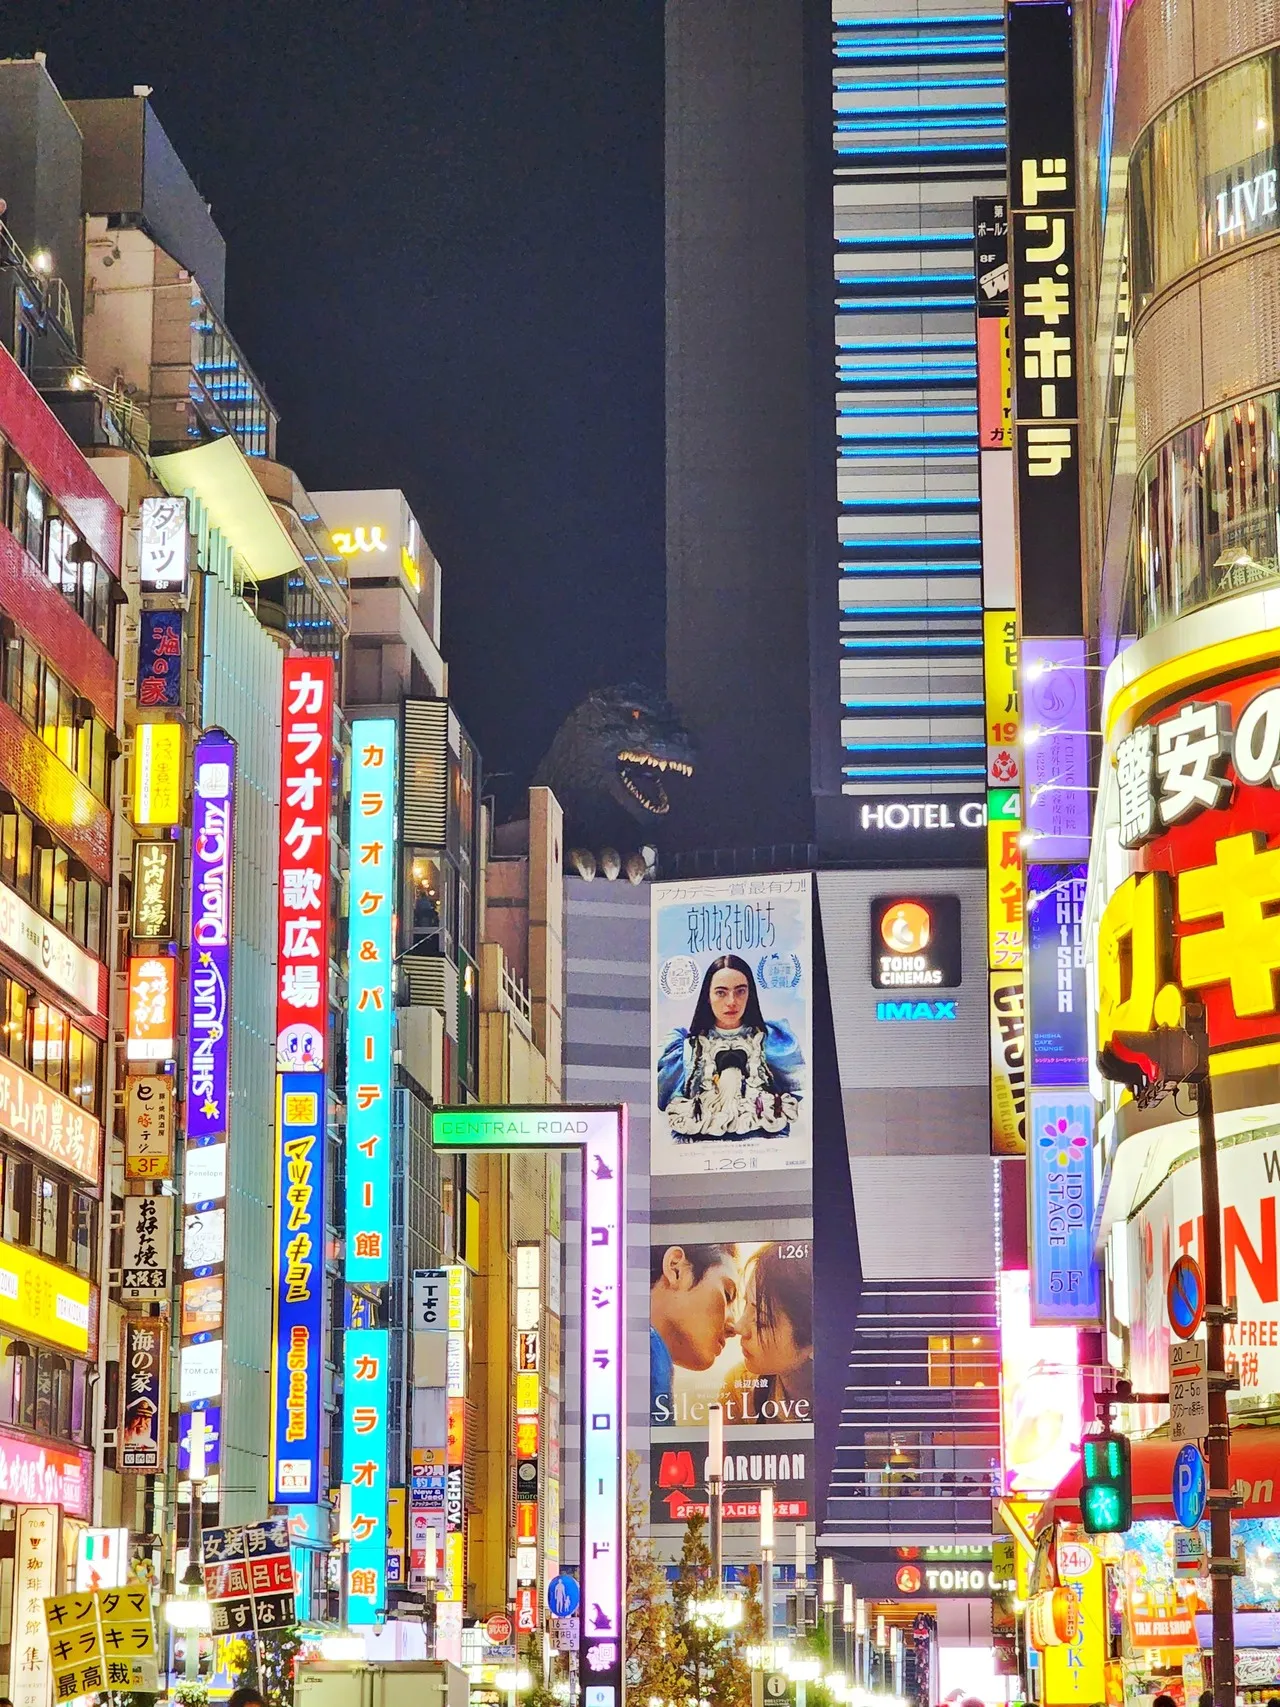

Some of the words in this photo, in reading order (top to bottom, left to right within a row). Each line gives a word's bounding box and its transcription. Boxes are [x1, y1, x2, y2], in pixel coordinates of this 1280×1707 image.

[1216, 169, 1278, 236] LIVE
[980, 254, 996, 263] 8F
[150, 503, 179, 574] ダーツ
[139, 626, 182, 705] 海の家
[861, 803, 955, 830] HOTEL
[281, 672, 324, 1008] カラオケ歌広場
[146, 925, 160, 935] 5F
[687, 901, 776, 954] 哀れなるものたち
[880, 956, 926, 971] TOHO
[880, 970, 942, 985] CINEMAS
[355, 745, 384, 1258] カラオケ&パーティー館
[876, 1002, 957, 1021] IMAX
[192, 968, 223, 1098] SHINJUKU
[287, 1096, 314, 1120] 薬
[442, 1121, 530, 1135] CENTRAL
[537, 1121, 589, 1134] ROAD
[137, 1158, 160, 1172] 3F
[703, 1157, 747, 1172] 1.26
[284, 1136, 317, 1303] マツモトキヨシ
[1047, 1172, 1066, 1248] STAGE
[1066, 1172, 1083, 1235] IDOL
[134, 1198, 159, 1268] お好み焼
[778, 1245, 804, 1259] 1.26
[124, 1270, 165, 1288] 大阪家
[1050, 1270, 1083, 1293] 5F
[288, 1326, 310, 1370] Shop
[1240, 1321, 1279, 1347] FREE
[130, 1329, 155, 1394] 海の家
[184, 1367, 201, 1375] TOM
[203, 1367, 219, 1375] CAT
[287, 1371, 308, 1410] Free
[590, 1224, 616, 1560] ゴジラロード
[741, 1391, 811, 1420] Love
[286, 1409, 308, 1442] Tax
[350, 1356, 378, 1596] カラオケ館
[413, 1466, 444, 1476] つり具
[447, 1469, 462, 1524] AGEHA
[1179, 1463, 1193, 1517] P
[204, 1527, 288, 1560] 女装男を
[1059, 1550, 1088, 1568] 24H
[925, 1570, 984, 1590] TOHO
[48, 1593, 146, 1625] キンタマ
[213, 1598, 294, 1630] 通すな!!
[552, 1619, 575, 1628] 16-5
[552, 1640, 575, 1648] 12-5
[1134, 1621, 1151, 1636] TAX
[1153, 1620, 1169, 1636] FREE
[1170, 1620, 1192, 1635] SHOP
[54, 1628, 149, 1661] キラキラ
[58, 1662, 130, 1698] 最高裁
